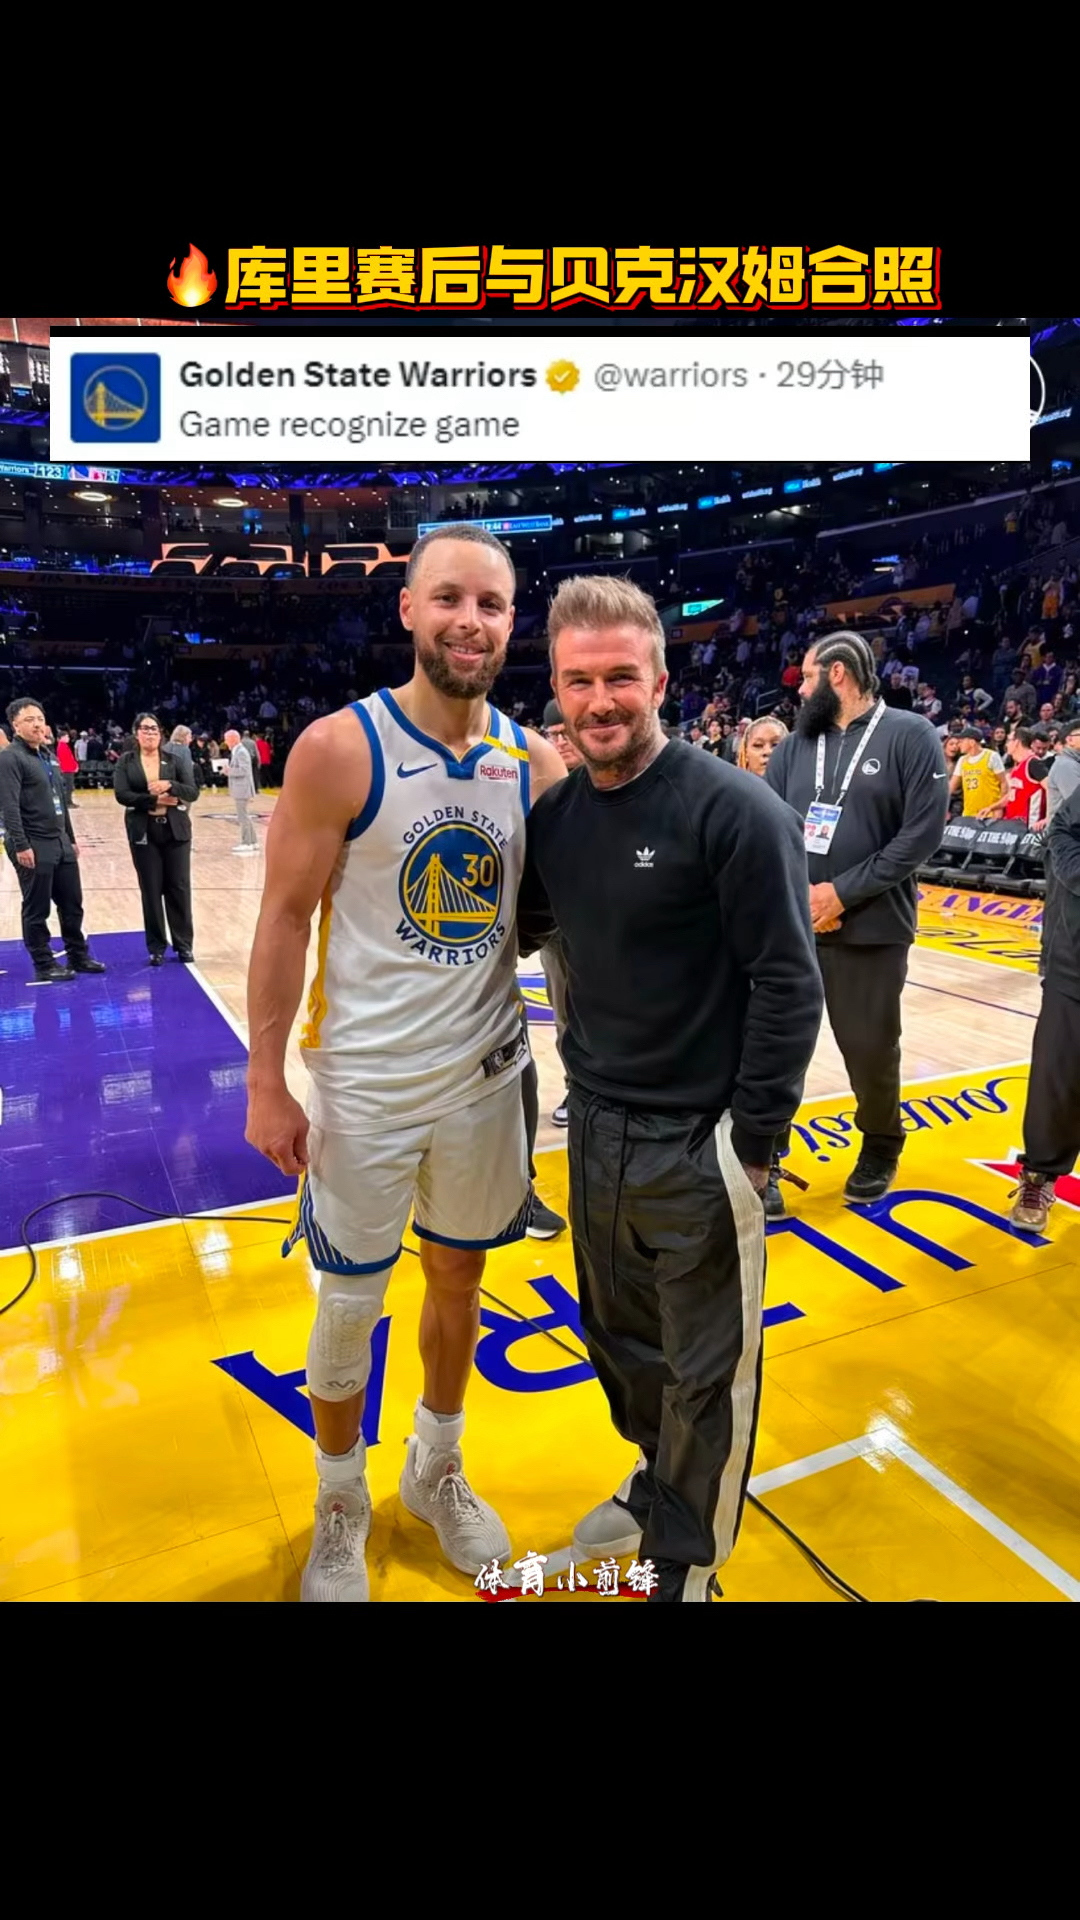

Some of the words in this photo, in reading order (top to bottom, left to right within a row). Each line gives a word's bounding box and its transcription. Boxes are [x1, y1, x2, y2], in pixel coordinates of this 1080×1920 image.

[39, 465, 62, 478] 123
[480, 764, 518, 779] Rakuten
[403, 806, 464, 845] GOLDEN
[471, 810, 508, 850] STATE
[462, 854, 495, 887] 30
[396, 917, 506, 966] WARRIORS
